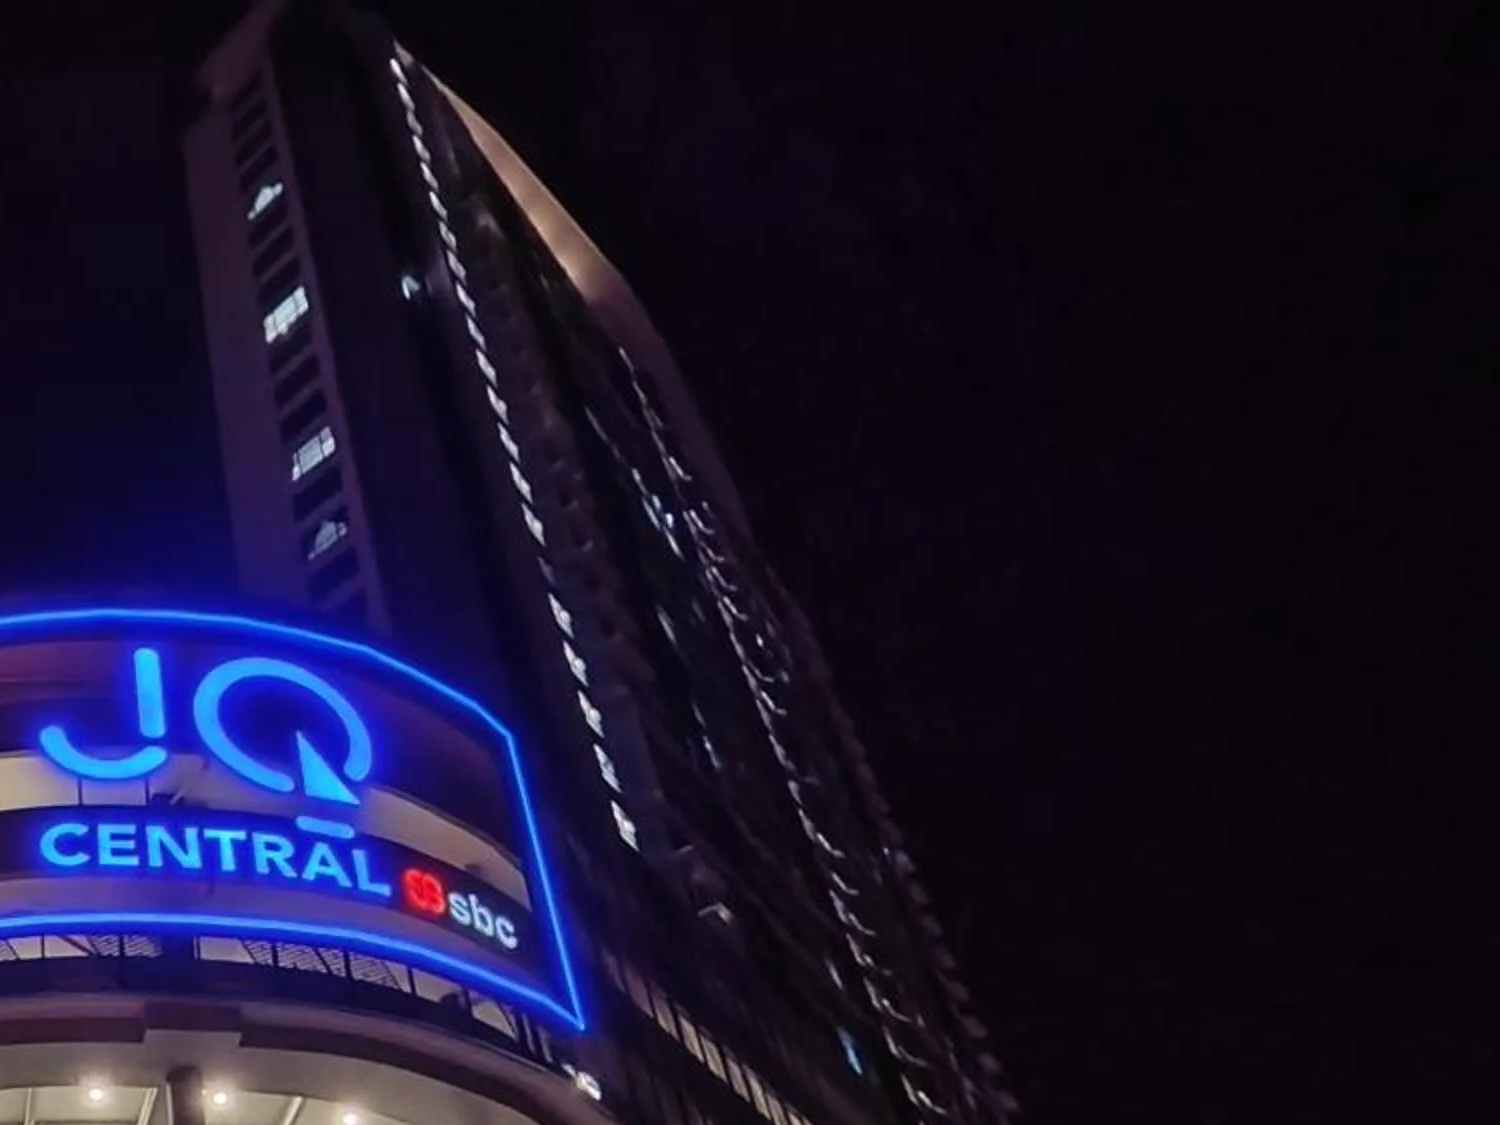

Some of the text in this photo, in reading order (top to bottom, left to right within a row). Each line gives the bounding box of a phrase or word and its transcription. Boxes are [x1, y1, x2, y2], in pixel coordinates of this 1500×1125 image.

[39, 647, 373, 806] JQ
[39, 822, 393, 898] CENTRAL
[448, 891, 519, 950] sbc
